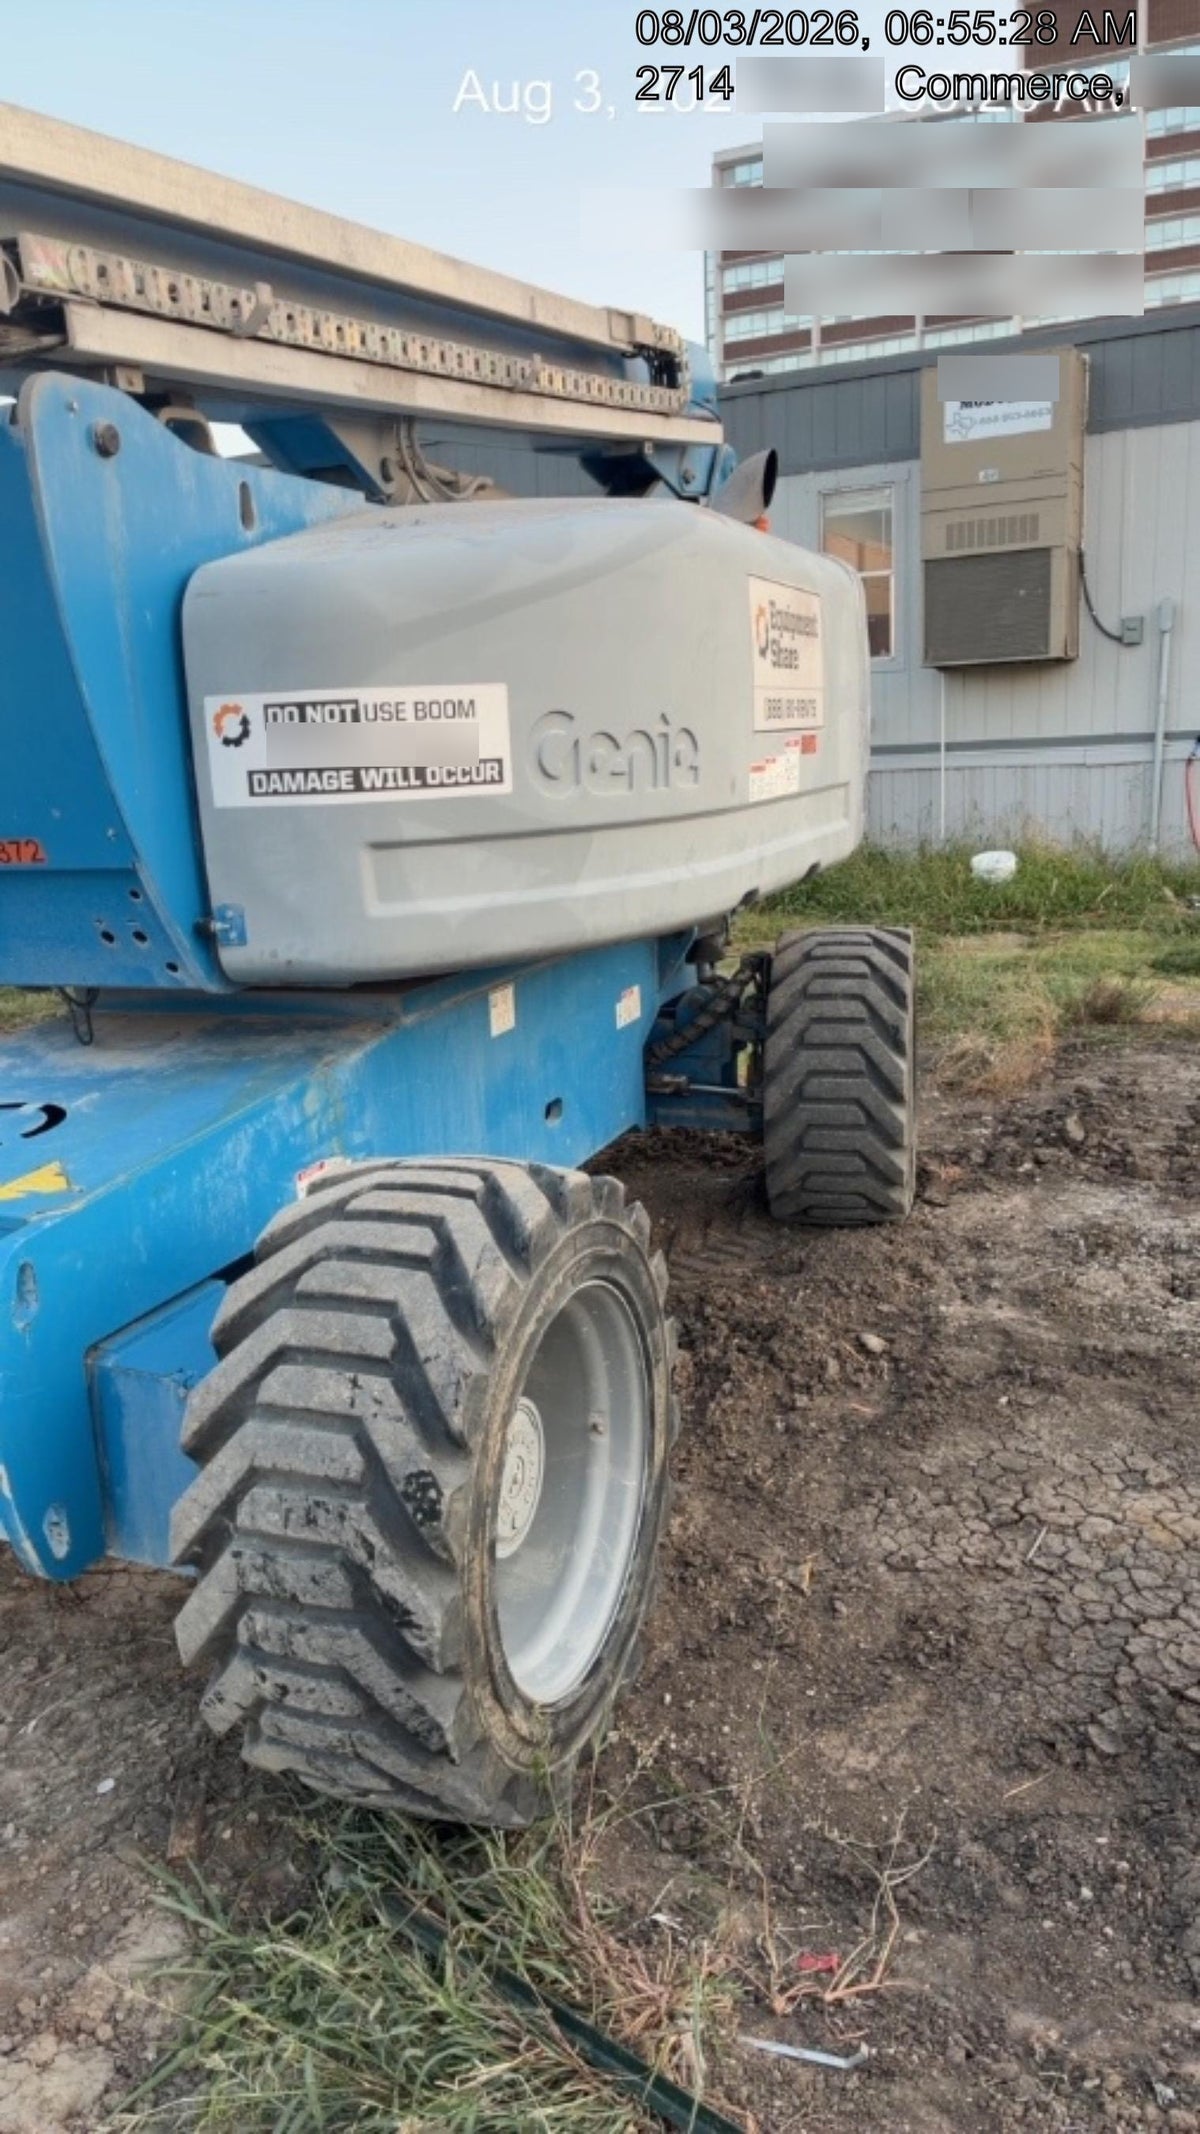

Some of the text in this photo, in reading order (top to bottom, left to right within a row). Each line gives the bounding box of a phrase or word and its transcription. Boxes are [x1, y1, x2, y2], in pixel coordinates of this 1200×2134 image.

[305, 703, 357, 724] NOT
[364, 701, 408, 722] USE
[414, 699, 476, 722] BOOM
[252, 762, 501, 794] DAMAGE WILL OCCUR
